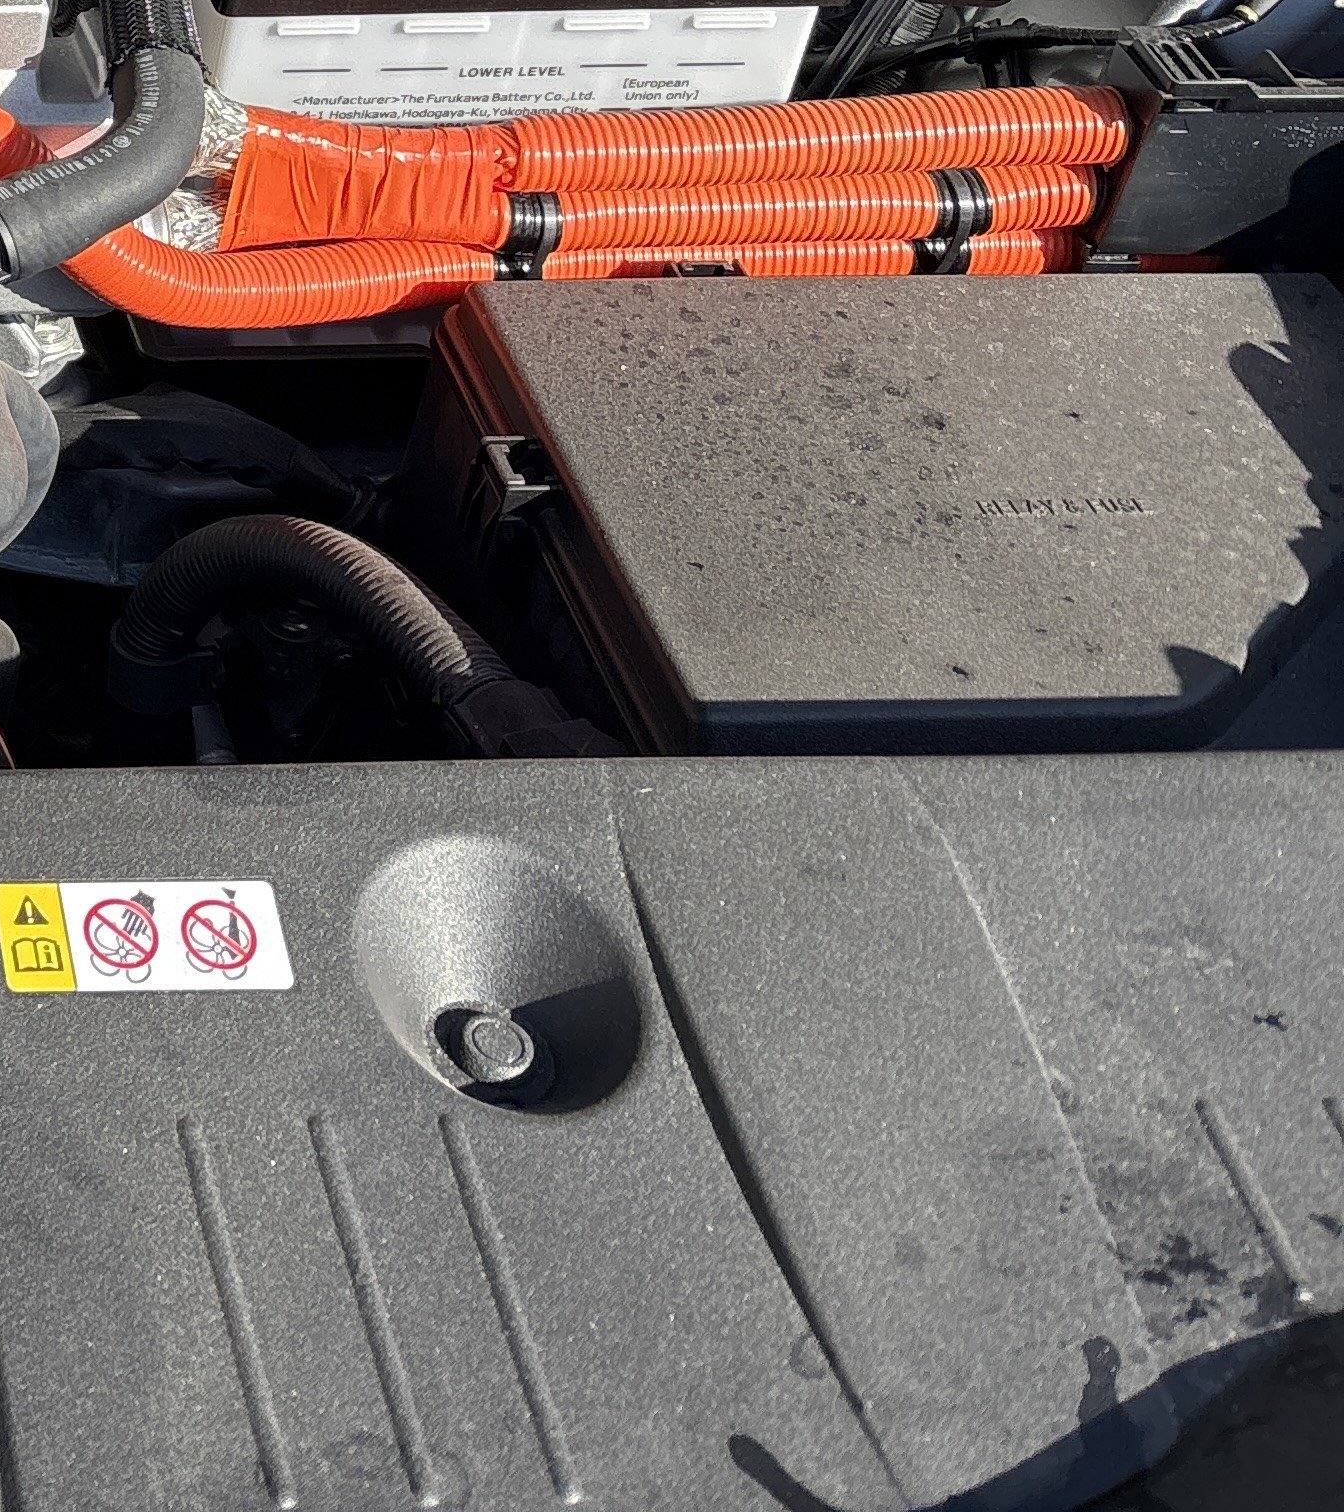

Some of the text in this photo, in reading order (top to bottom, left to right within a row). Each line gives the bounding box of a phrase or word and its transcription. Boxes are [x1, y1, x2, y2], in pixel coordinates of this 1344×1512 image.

[459, 66, 566, 78] LOWER LEVEL
[426, 93, 489, 104] Furukawa
[492, 91, 542, 103] Battery
[544, 91, 596, 103] Co.,Ltd.
[625, 92, 661, 101] Union
